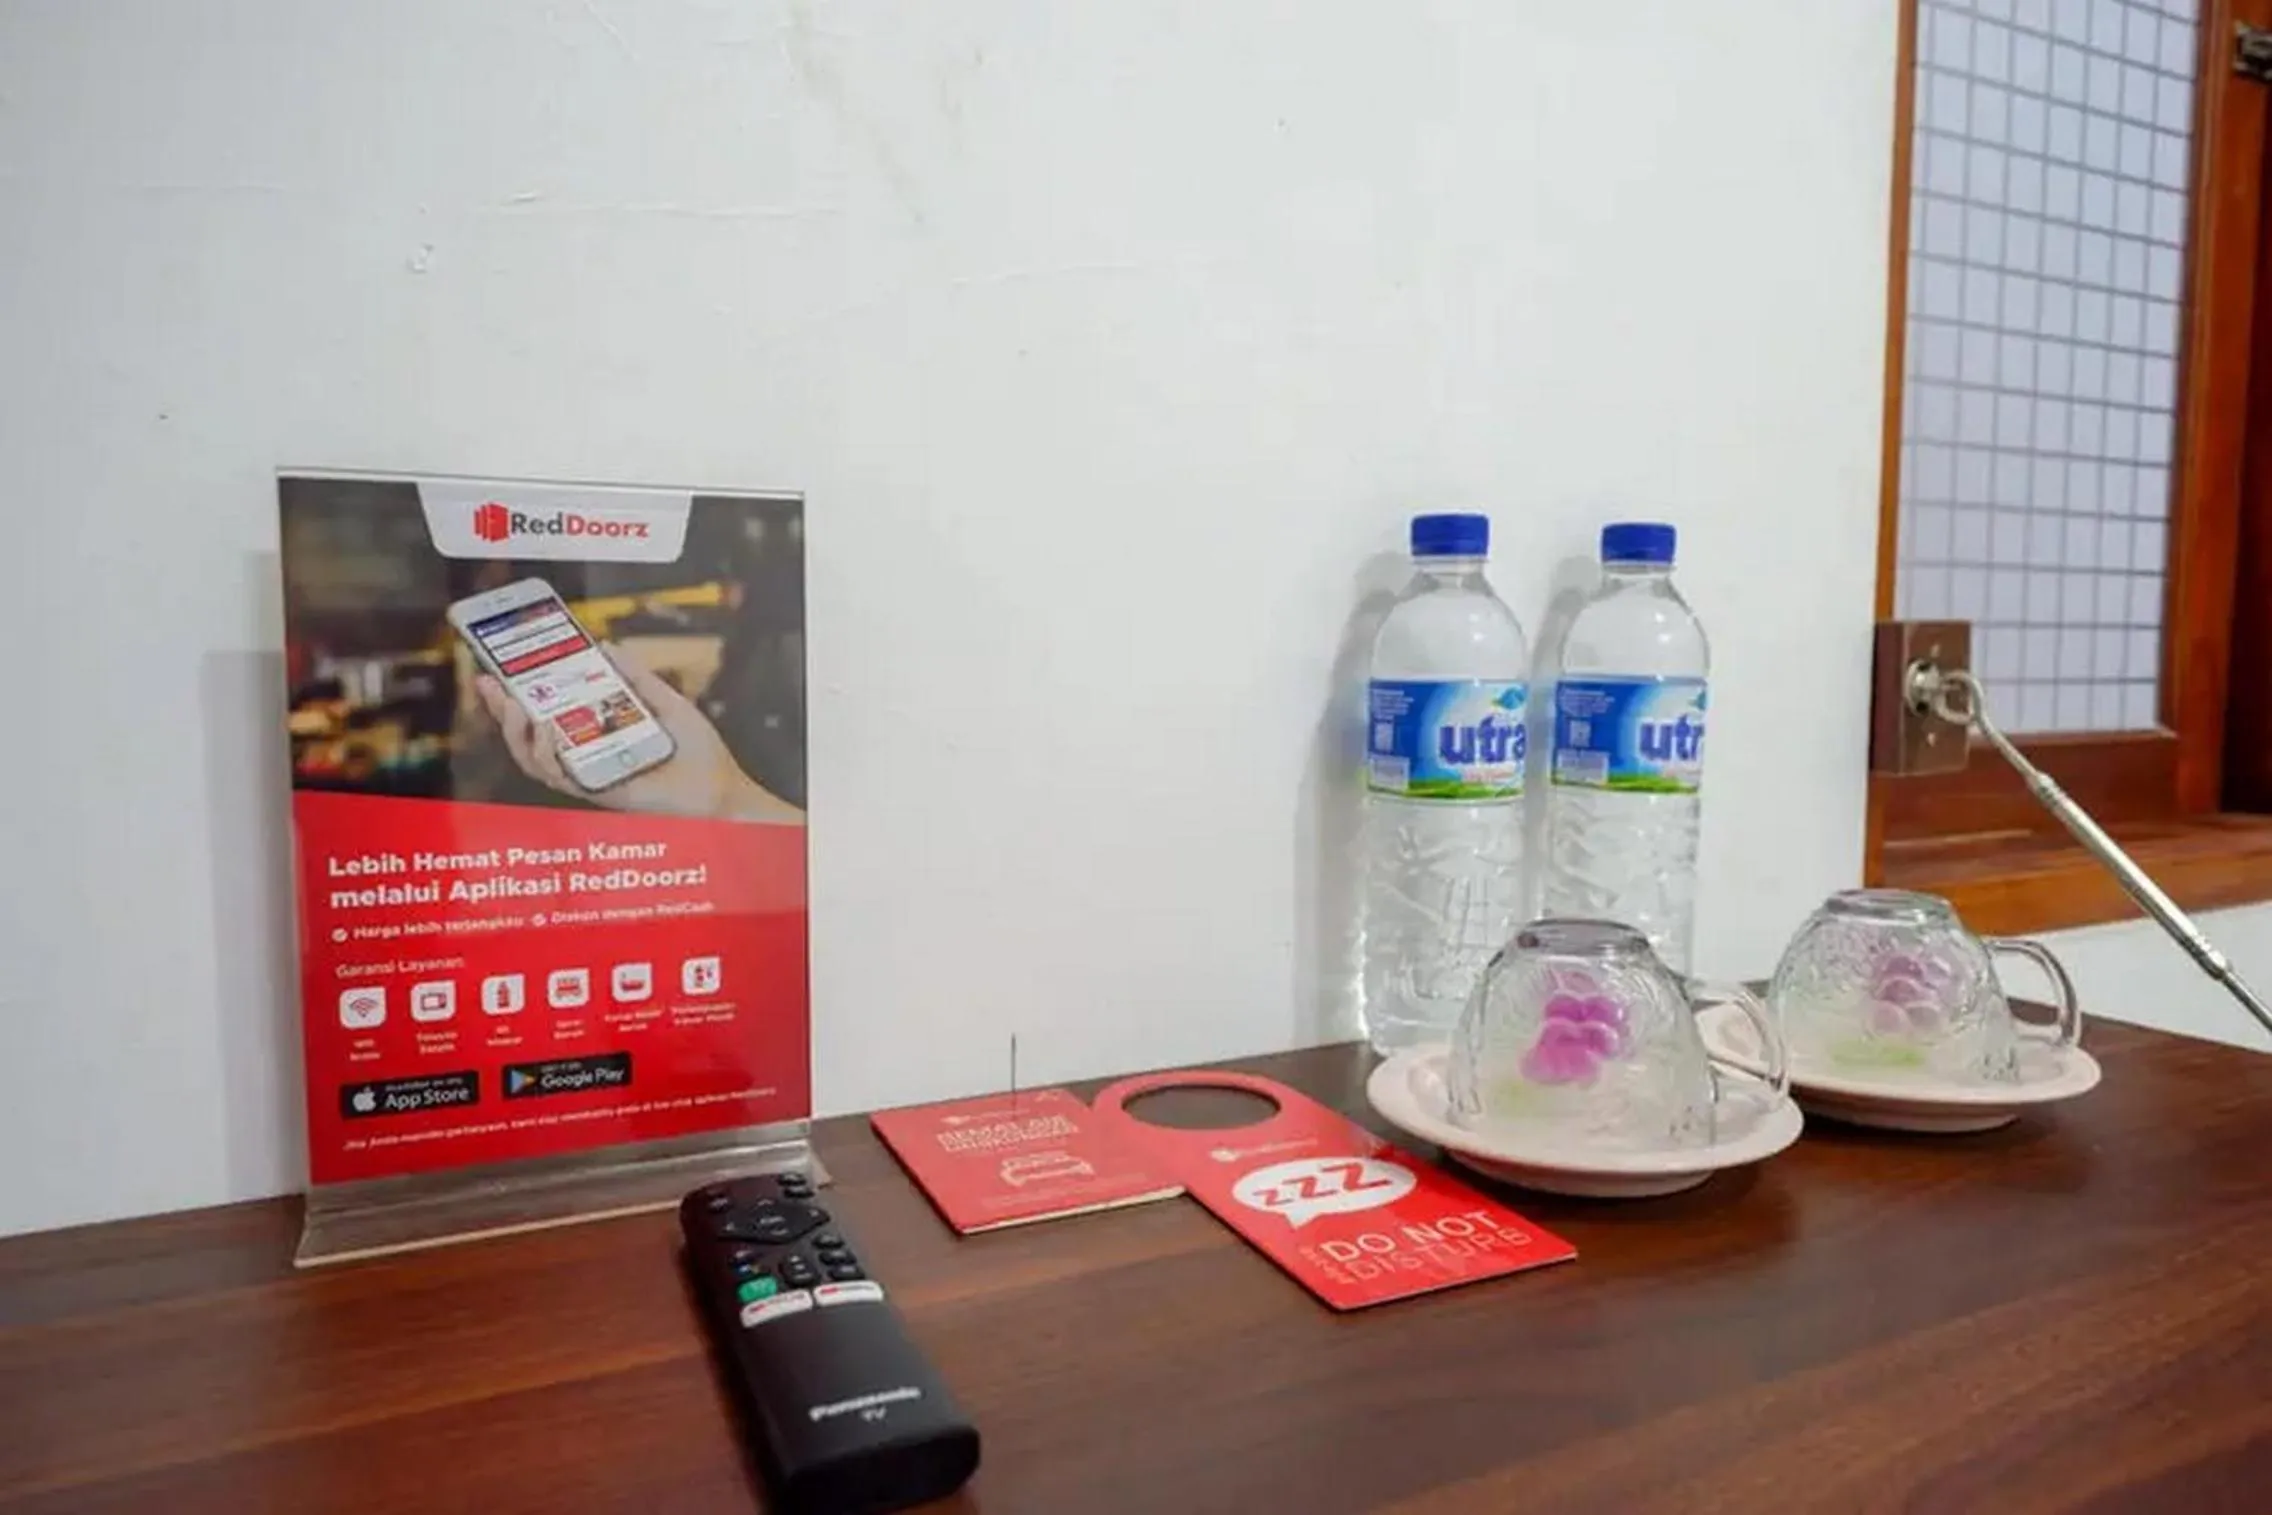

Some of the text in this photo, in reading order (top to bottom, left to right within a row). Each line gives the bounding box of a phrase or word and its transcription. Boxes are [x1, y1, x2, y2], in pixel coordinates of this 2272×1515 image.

[510, 511, 649, 538] RedDoorz
[328, 841, 667, 877] Lebih Hemat Pesan Kamar
[330, 863, 707, 909] melalui Aplikasi RedDoorz!
[540, 1067, 625, 1090] Google Play
[384, 1087, 471, 1111] App Store
[1319, 1210, 1501, 1262] DO NOT
[1344, 1226, 1533, 1281] DISTURB
